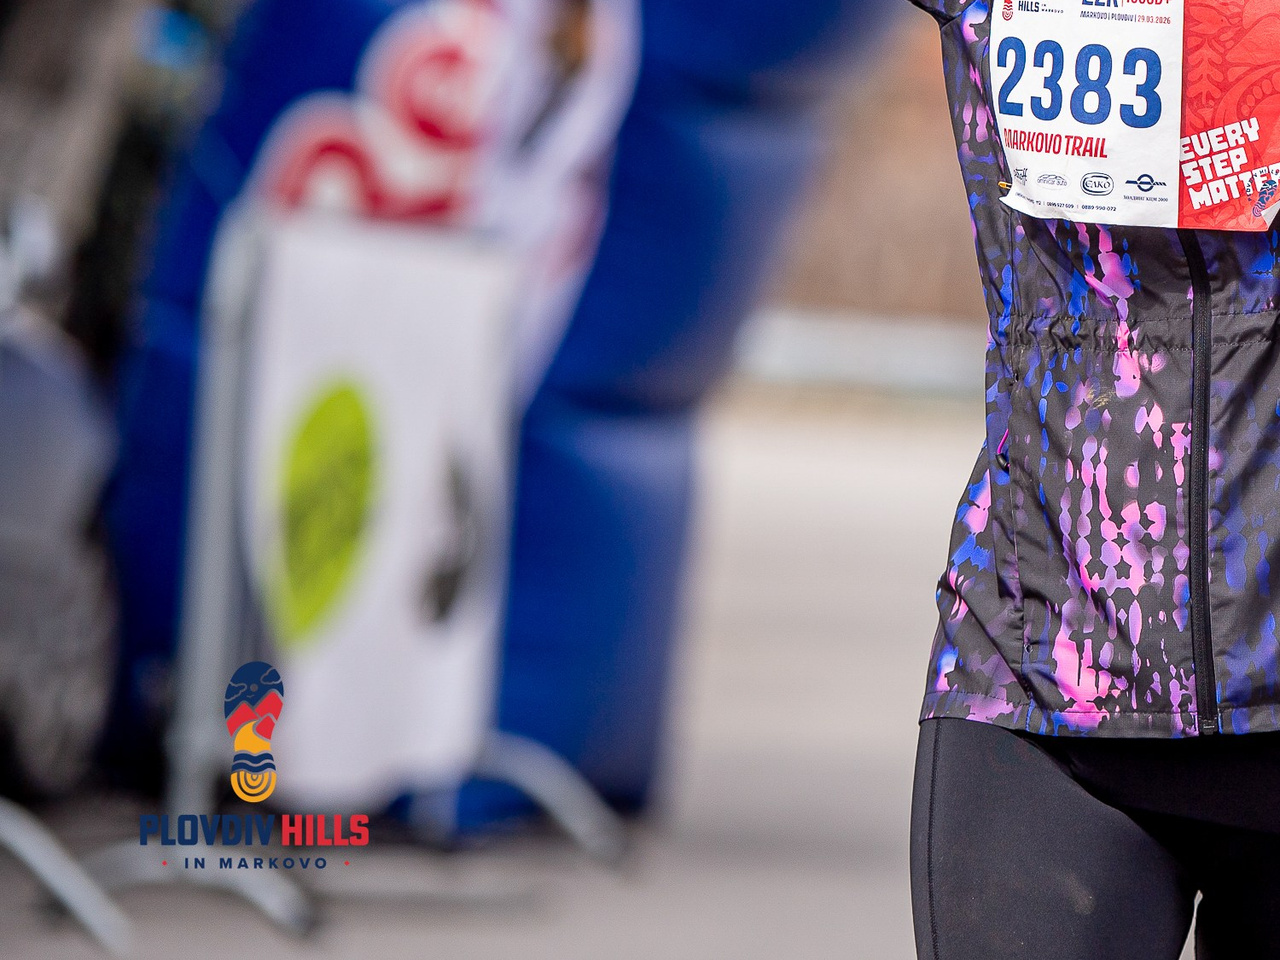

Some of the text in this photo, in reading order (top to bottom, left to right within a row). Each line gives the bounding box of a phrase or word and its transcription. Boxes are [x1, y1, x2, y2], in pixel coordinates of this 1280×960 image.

[1018, 0, 1039, 12] HILLS
[997, 36, 1162, 129] 2383
[1003, 128, 1108, 158] MARKOVO TRAIL
[1179, 117, 1260, 162] EVERY
[1181, 147, 1248, 186] STEP
